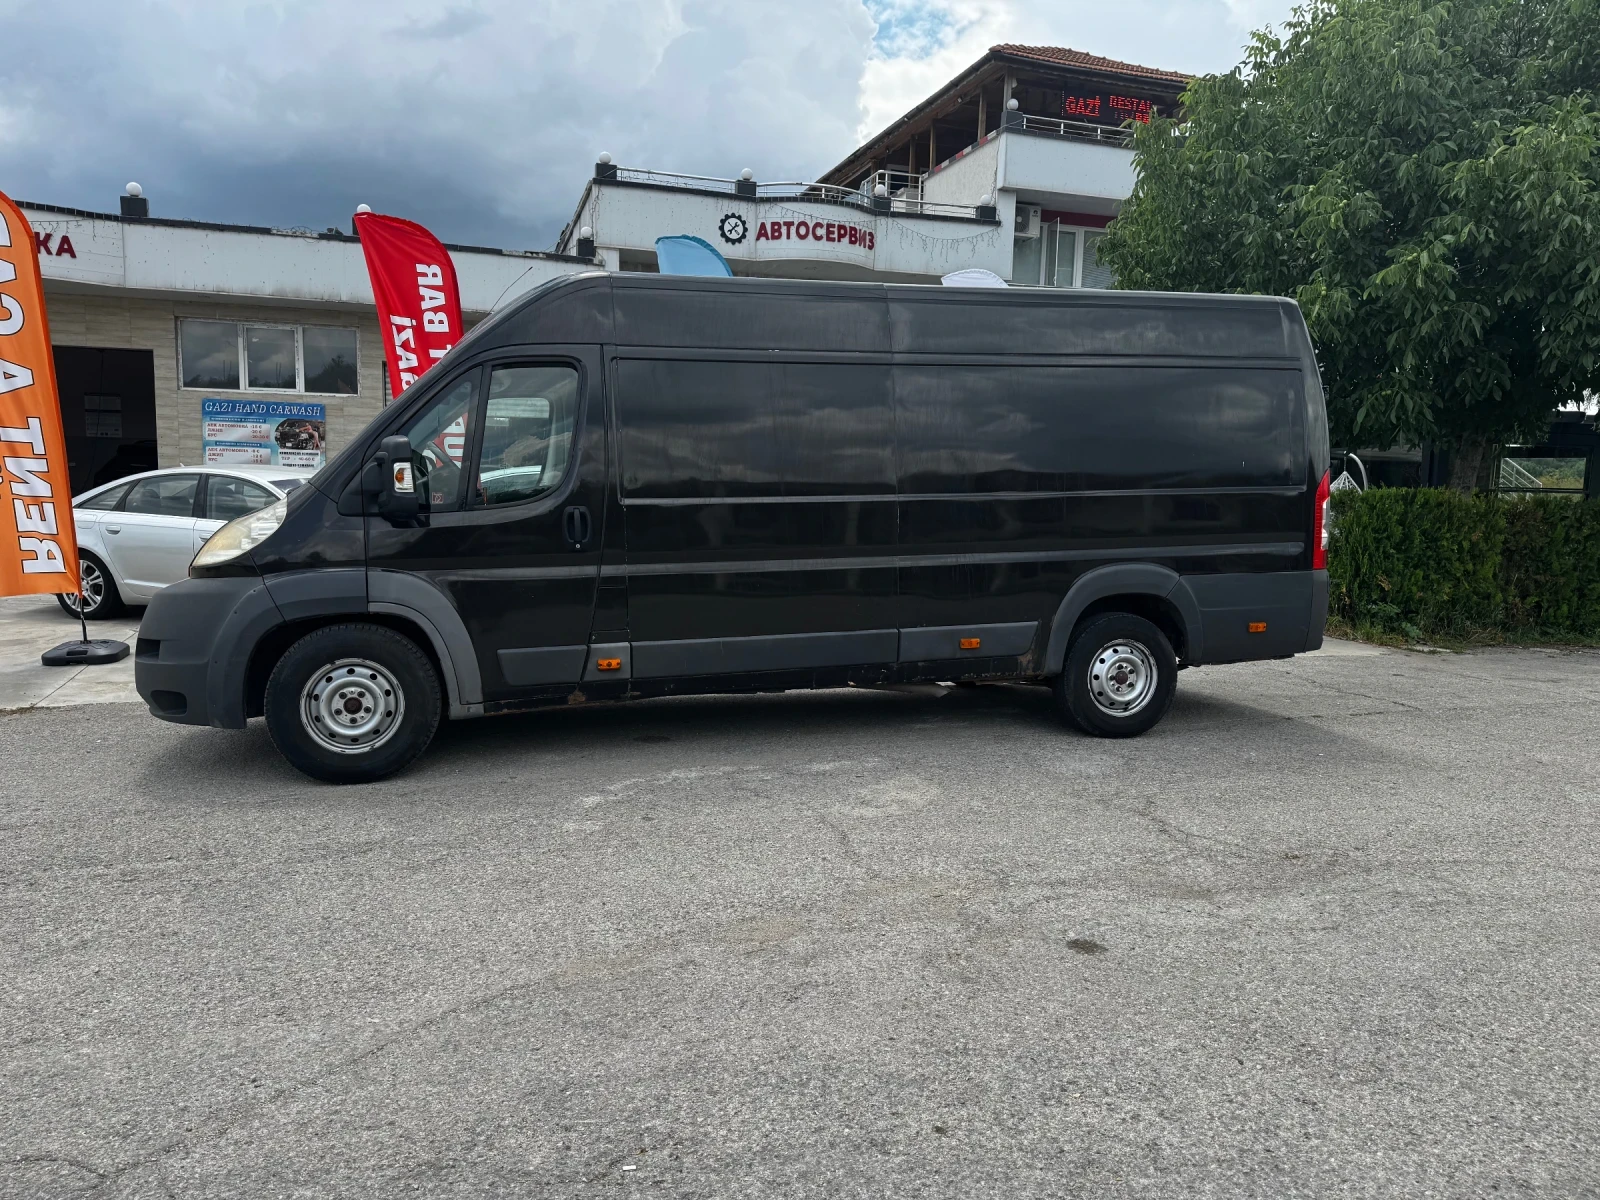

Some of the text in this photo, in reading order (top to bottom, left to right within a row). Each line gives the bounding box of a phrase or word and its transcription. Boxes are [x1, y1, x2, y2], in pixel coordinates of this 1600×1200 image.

[756, 221, 875, 250] АВТОСЕРВИЗ
[205, 402, 321, 416] GAZI HAND CARWASH
